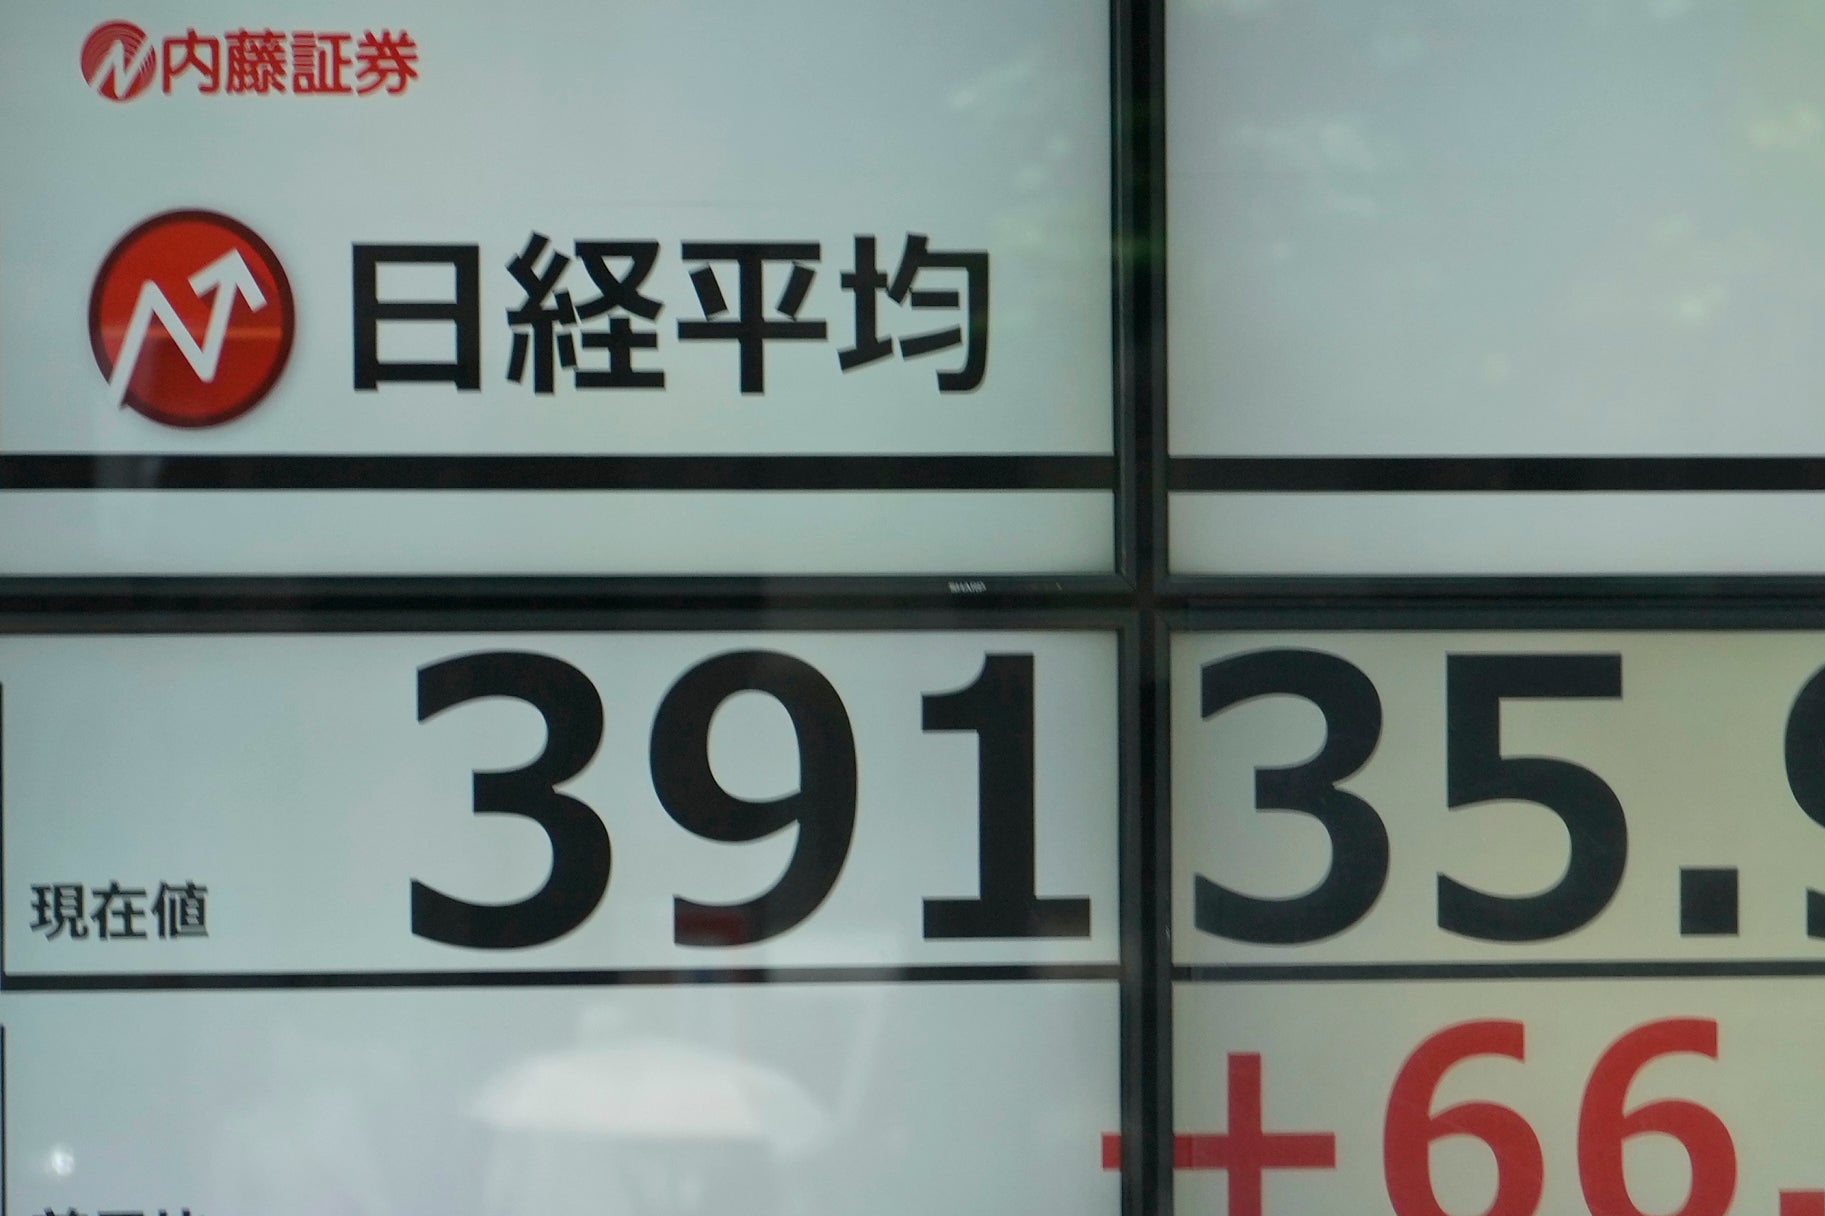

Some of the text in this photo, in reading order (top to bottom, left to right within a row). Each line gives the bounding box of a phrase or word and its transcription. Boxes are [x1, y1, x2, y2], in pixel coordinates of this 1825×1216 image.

[162, 28, 418, 96] 内藤証券
[350, 231, 990, 396] 日経平均
[29, 880, 209, 941] 現在値
